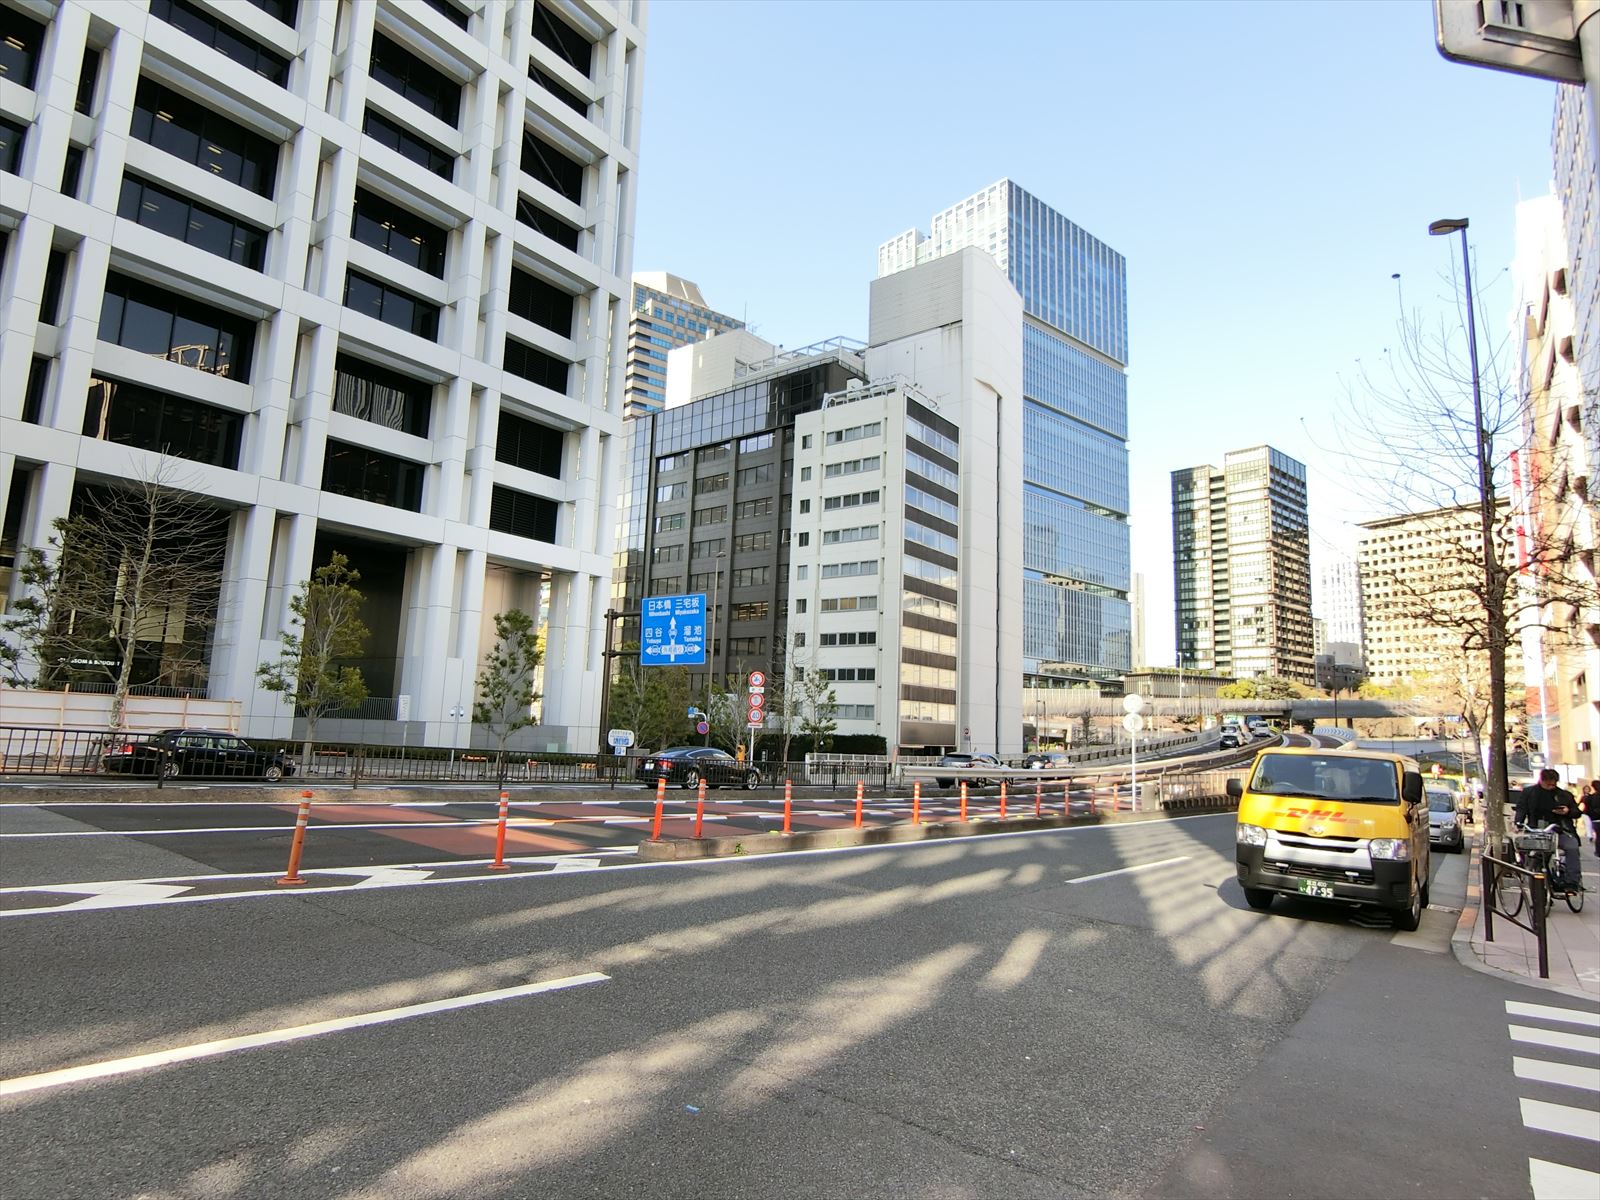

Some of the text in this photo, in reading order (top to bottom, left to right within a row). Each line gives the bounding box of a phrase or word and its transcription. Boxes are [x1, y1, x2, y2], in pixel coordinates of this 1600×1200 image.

[648, 600, 671, 610] 日本橋
[645, 627, 663, 638] 四谷
[1286, 807, 1348, 823] DHL
